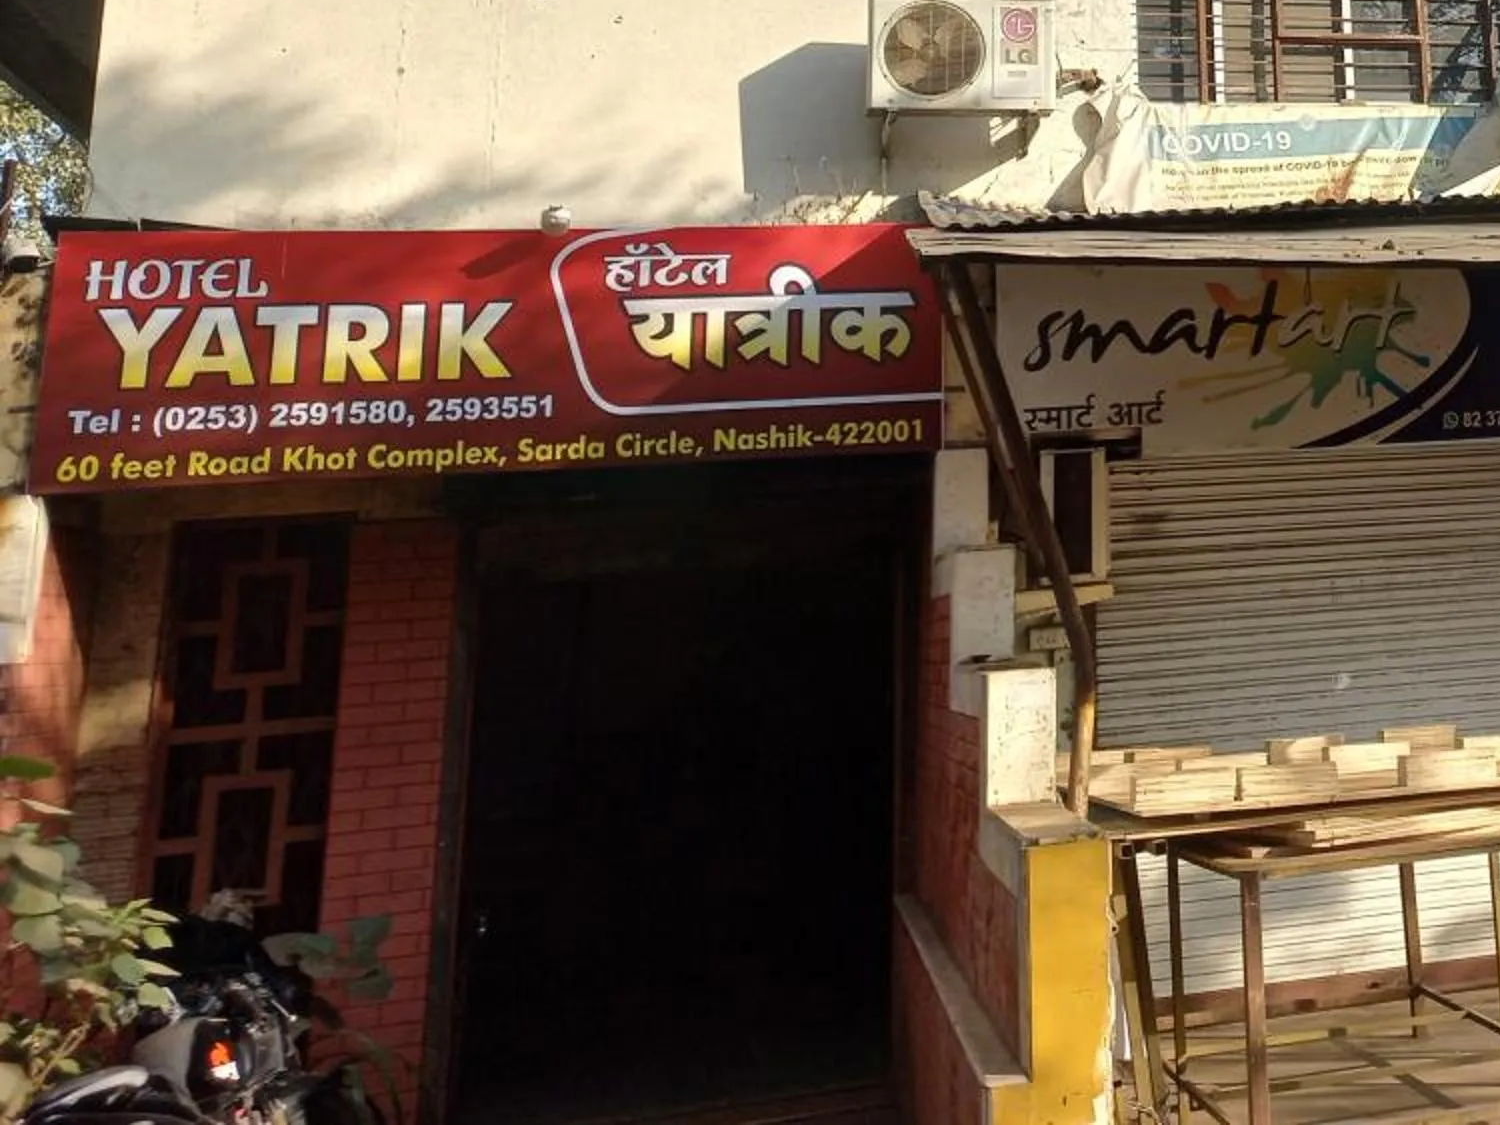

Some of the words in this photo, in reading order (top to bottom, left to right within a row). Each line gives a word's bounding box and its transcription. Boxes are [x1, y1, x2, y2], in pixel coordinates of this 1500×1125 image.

[1005, 49, 1033, 65] LG
[84, 256, 270, 302] HOTEL
[604, 243, 732, 292] हॉटेल
[622, 264, 916, 371] यात्रीक
[97, 300, 517, 392] YATRIK
[68, 408, 121, 435] Tel
[152, 403, 259, 438] (0253)
[269, 399, 416, 428] 2591580,
[425, 394, 554, 424] 2593551
[1023, 393, 1096, 431] स्मार्ट
[1107, 389, 1166, 427] आर्ट
[56, 454, 100, 484] 60
[110, 451, 177, 481] feet
[187, 446, 271, 476] Road
[283, 442, 358, 473] Khot
[367, 440, 507, 469] Complex,
[517, 434, 605, 464] Sarda
[616, 429, 705, 458] Circle,
[713, 418, 924, 453] Nashik-422001
